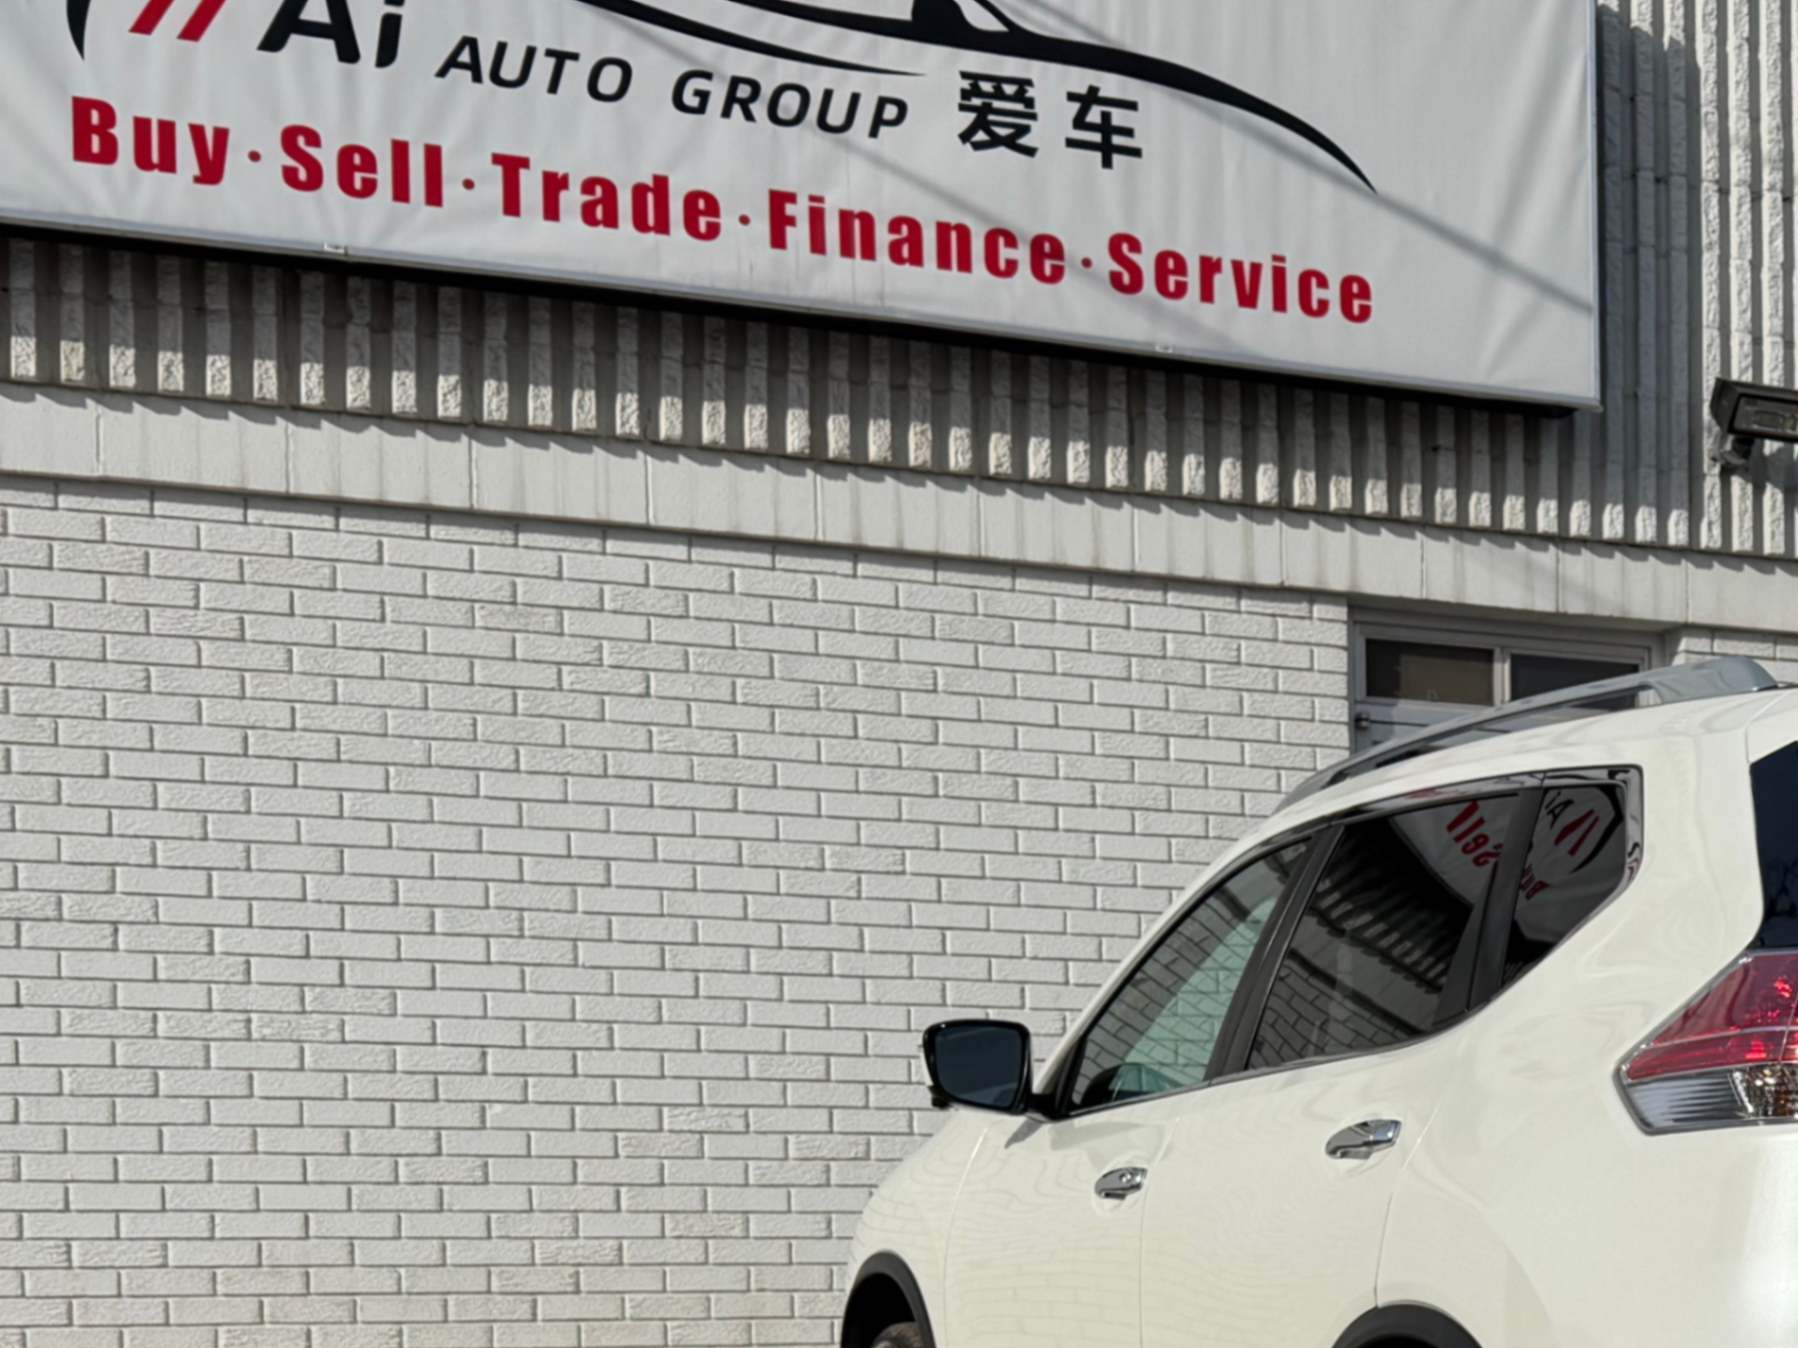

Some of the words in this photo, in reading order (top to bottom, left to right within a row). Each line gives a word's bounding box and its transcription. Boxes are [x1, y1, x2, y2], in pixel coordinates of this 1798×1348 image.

[257, 0, 403, 68] Ai
[435, 36, 632, 103] AUTO
[672, 70, 909, 139] GROUP
[957, 70, 1143, 170] 爱车
[72, 95, 230, 186] Buy
[281, 124, 443, 207] Sell
[491, 152, 722, 242] Trade
[768, 189, 1066, 284] Finance
[1107, 232, 1374, 325] Service
